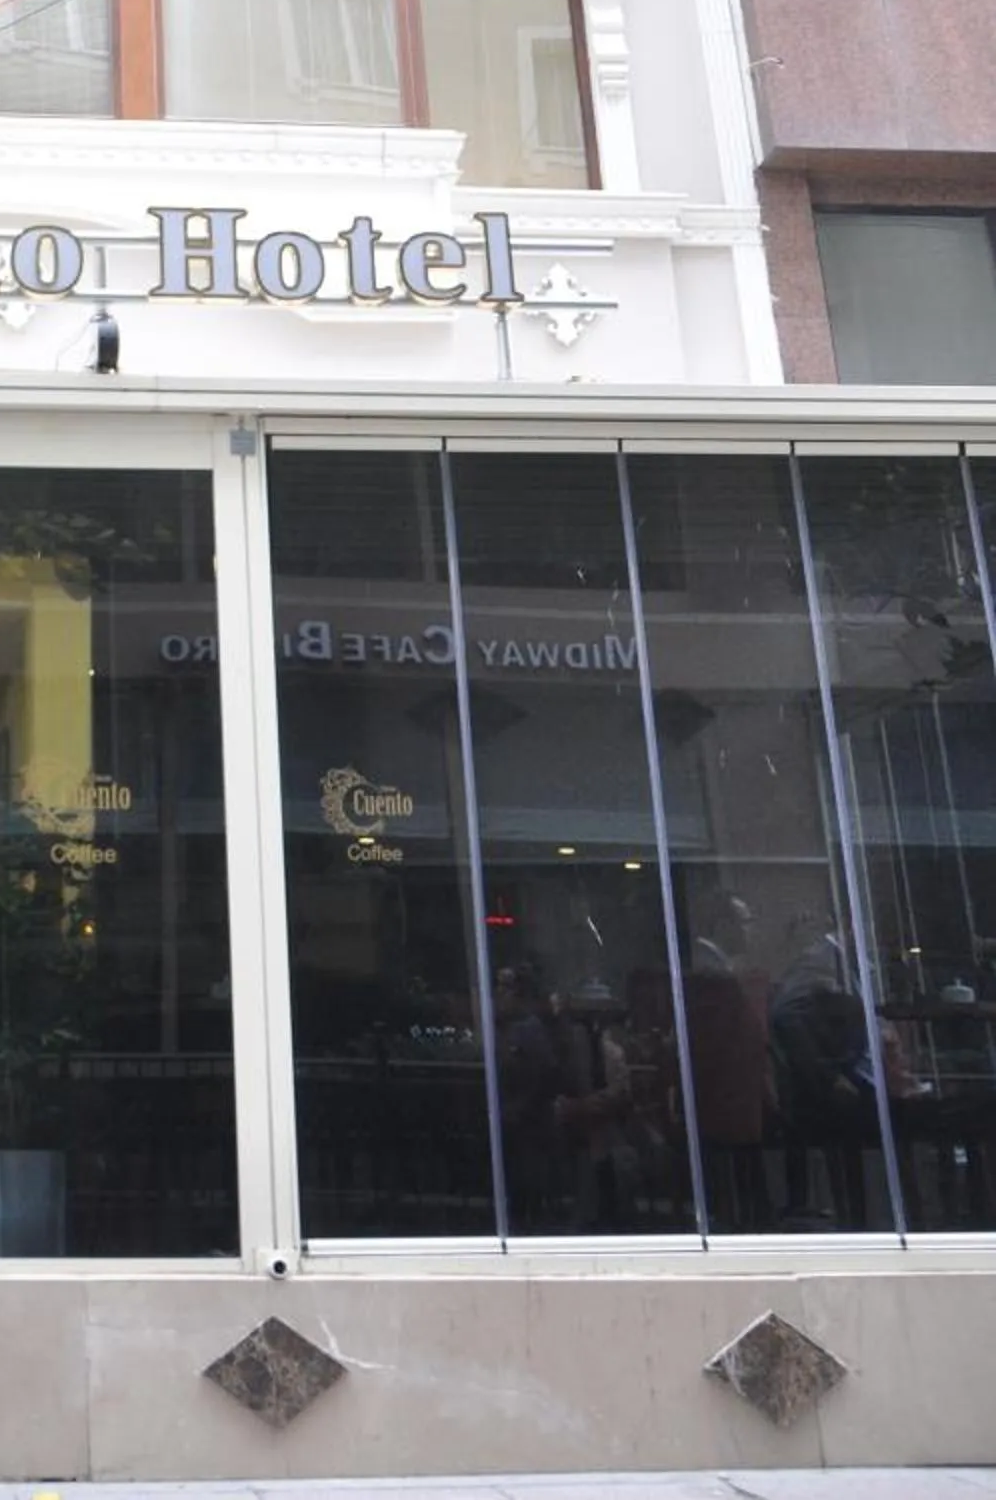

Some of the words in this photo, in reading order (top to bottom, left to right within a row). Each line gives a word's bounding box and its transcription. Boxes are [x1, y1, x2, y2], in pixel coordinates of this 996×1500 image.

[147, 207, 524, 301] Hotel
[353, 789, 413, 817] Cuento
[50, 843, 117, 864] Coffee
[347, 844, 403, 862] Coffee
